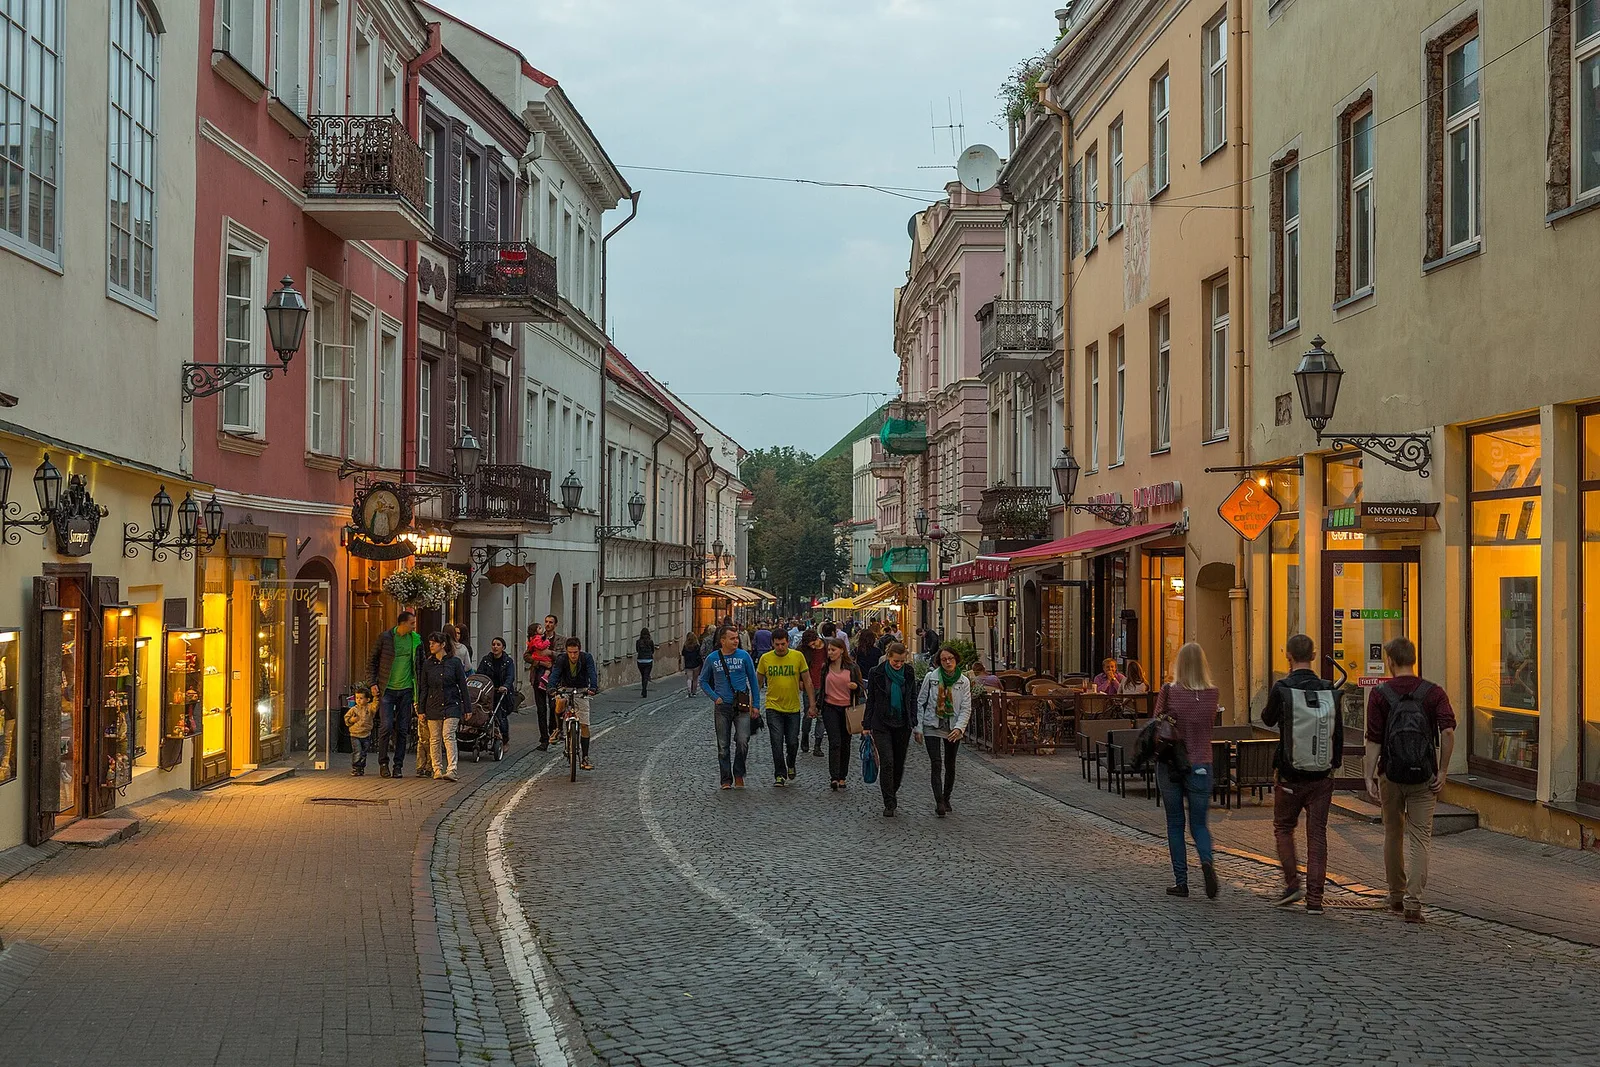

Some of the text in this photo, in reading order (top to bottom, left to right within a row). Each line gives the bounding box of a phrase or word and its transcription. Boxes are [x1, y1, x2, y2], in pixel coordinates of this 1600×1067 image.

[1367, 506, 1418, 515] KNYGYNAS
[1233, 512, 1267, 522] coffee
[230, 530, 267, 550] SUVENYRAI
[768, 665, 796, 676] BRAZIL
[1319, 728, 1328, 766] ORTLIEB
